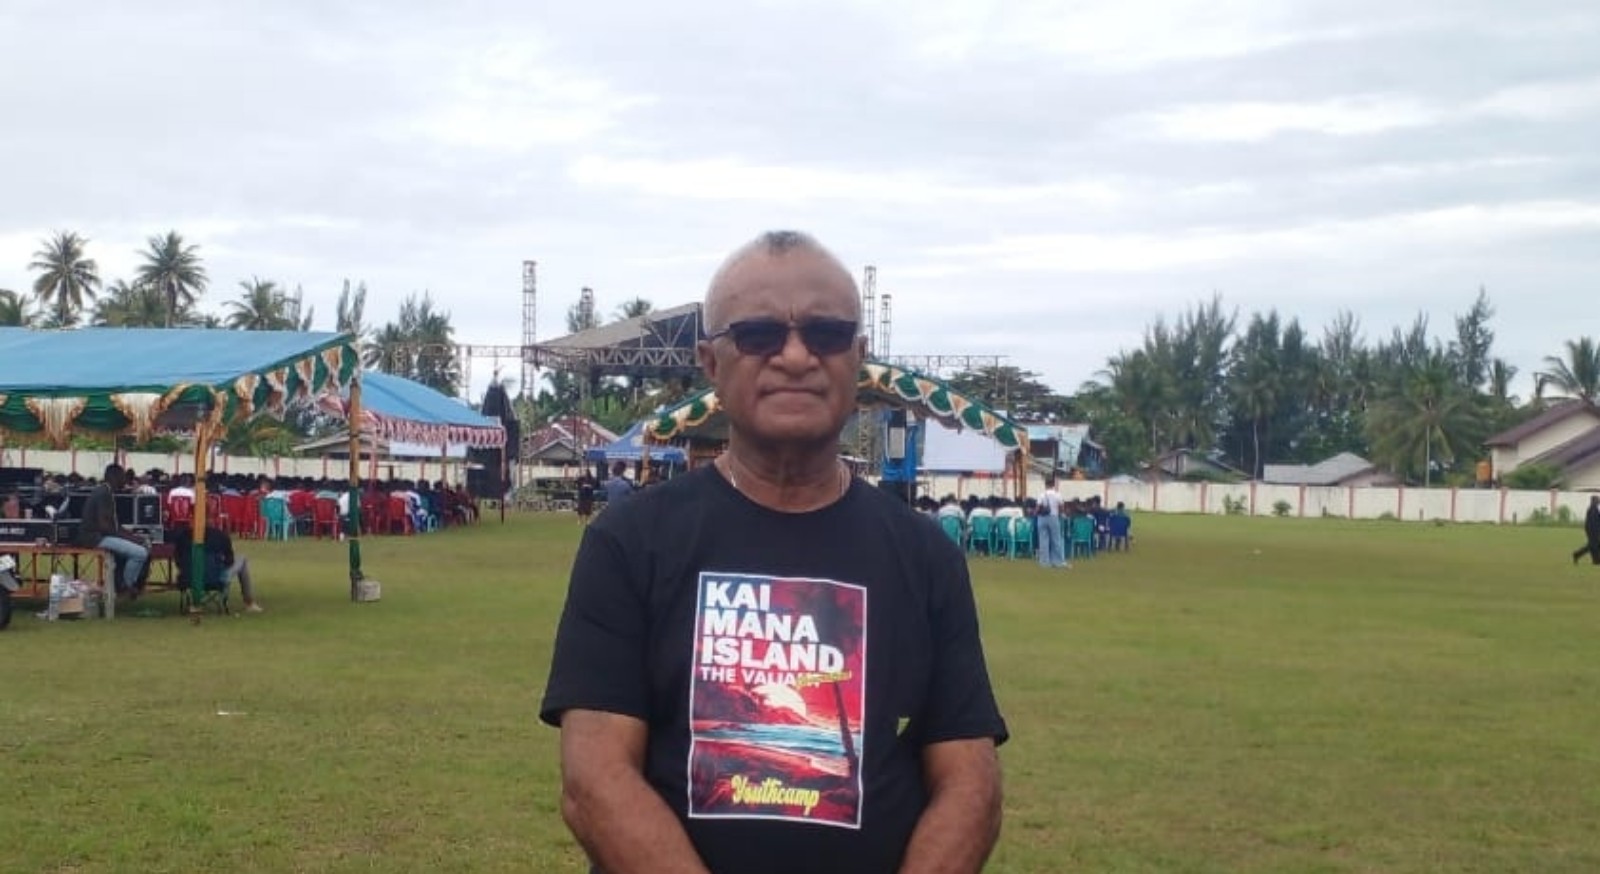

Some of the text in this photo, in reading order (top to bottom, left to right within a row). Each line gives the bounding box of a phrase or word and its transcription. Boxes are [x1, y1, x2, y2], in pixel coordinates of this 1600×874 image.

[705, 581, 770, 612] KAI
[704, 608, 819, 643] MANA
[701, 636, 844, 674] ISLAND
[701, 667, 737, 683] THE
[741, 669, 820, 688] VALIA
[731, 775, 820, 816] Youthcamp
